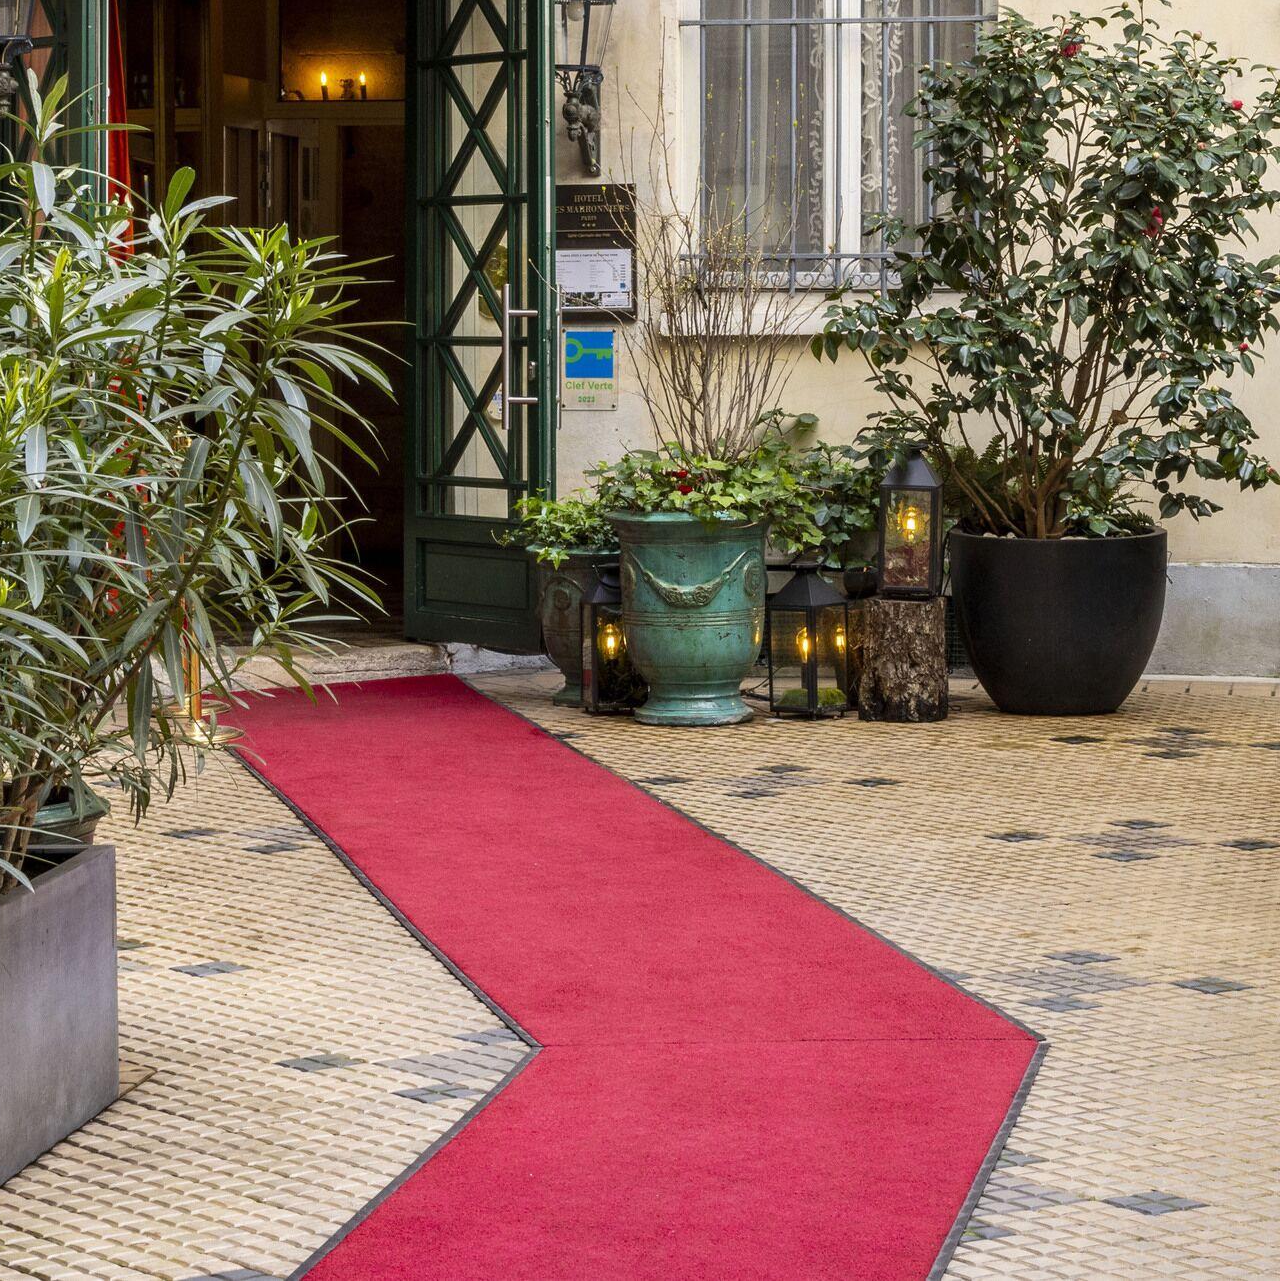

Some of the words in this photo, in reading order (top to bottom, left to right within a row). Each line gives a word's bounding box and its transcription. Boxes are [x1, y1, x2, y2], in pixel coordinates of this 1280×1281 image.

[574, 194, 603, 203] HOTEL
[565, 381, 584, 389] Clef
[588, 382, 613, 390] Verte
